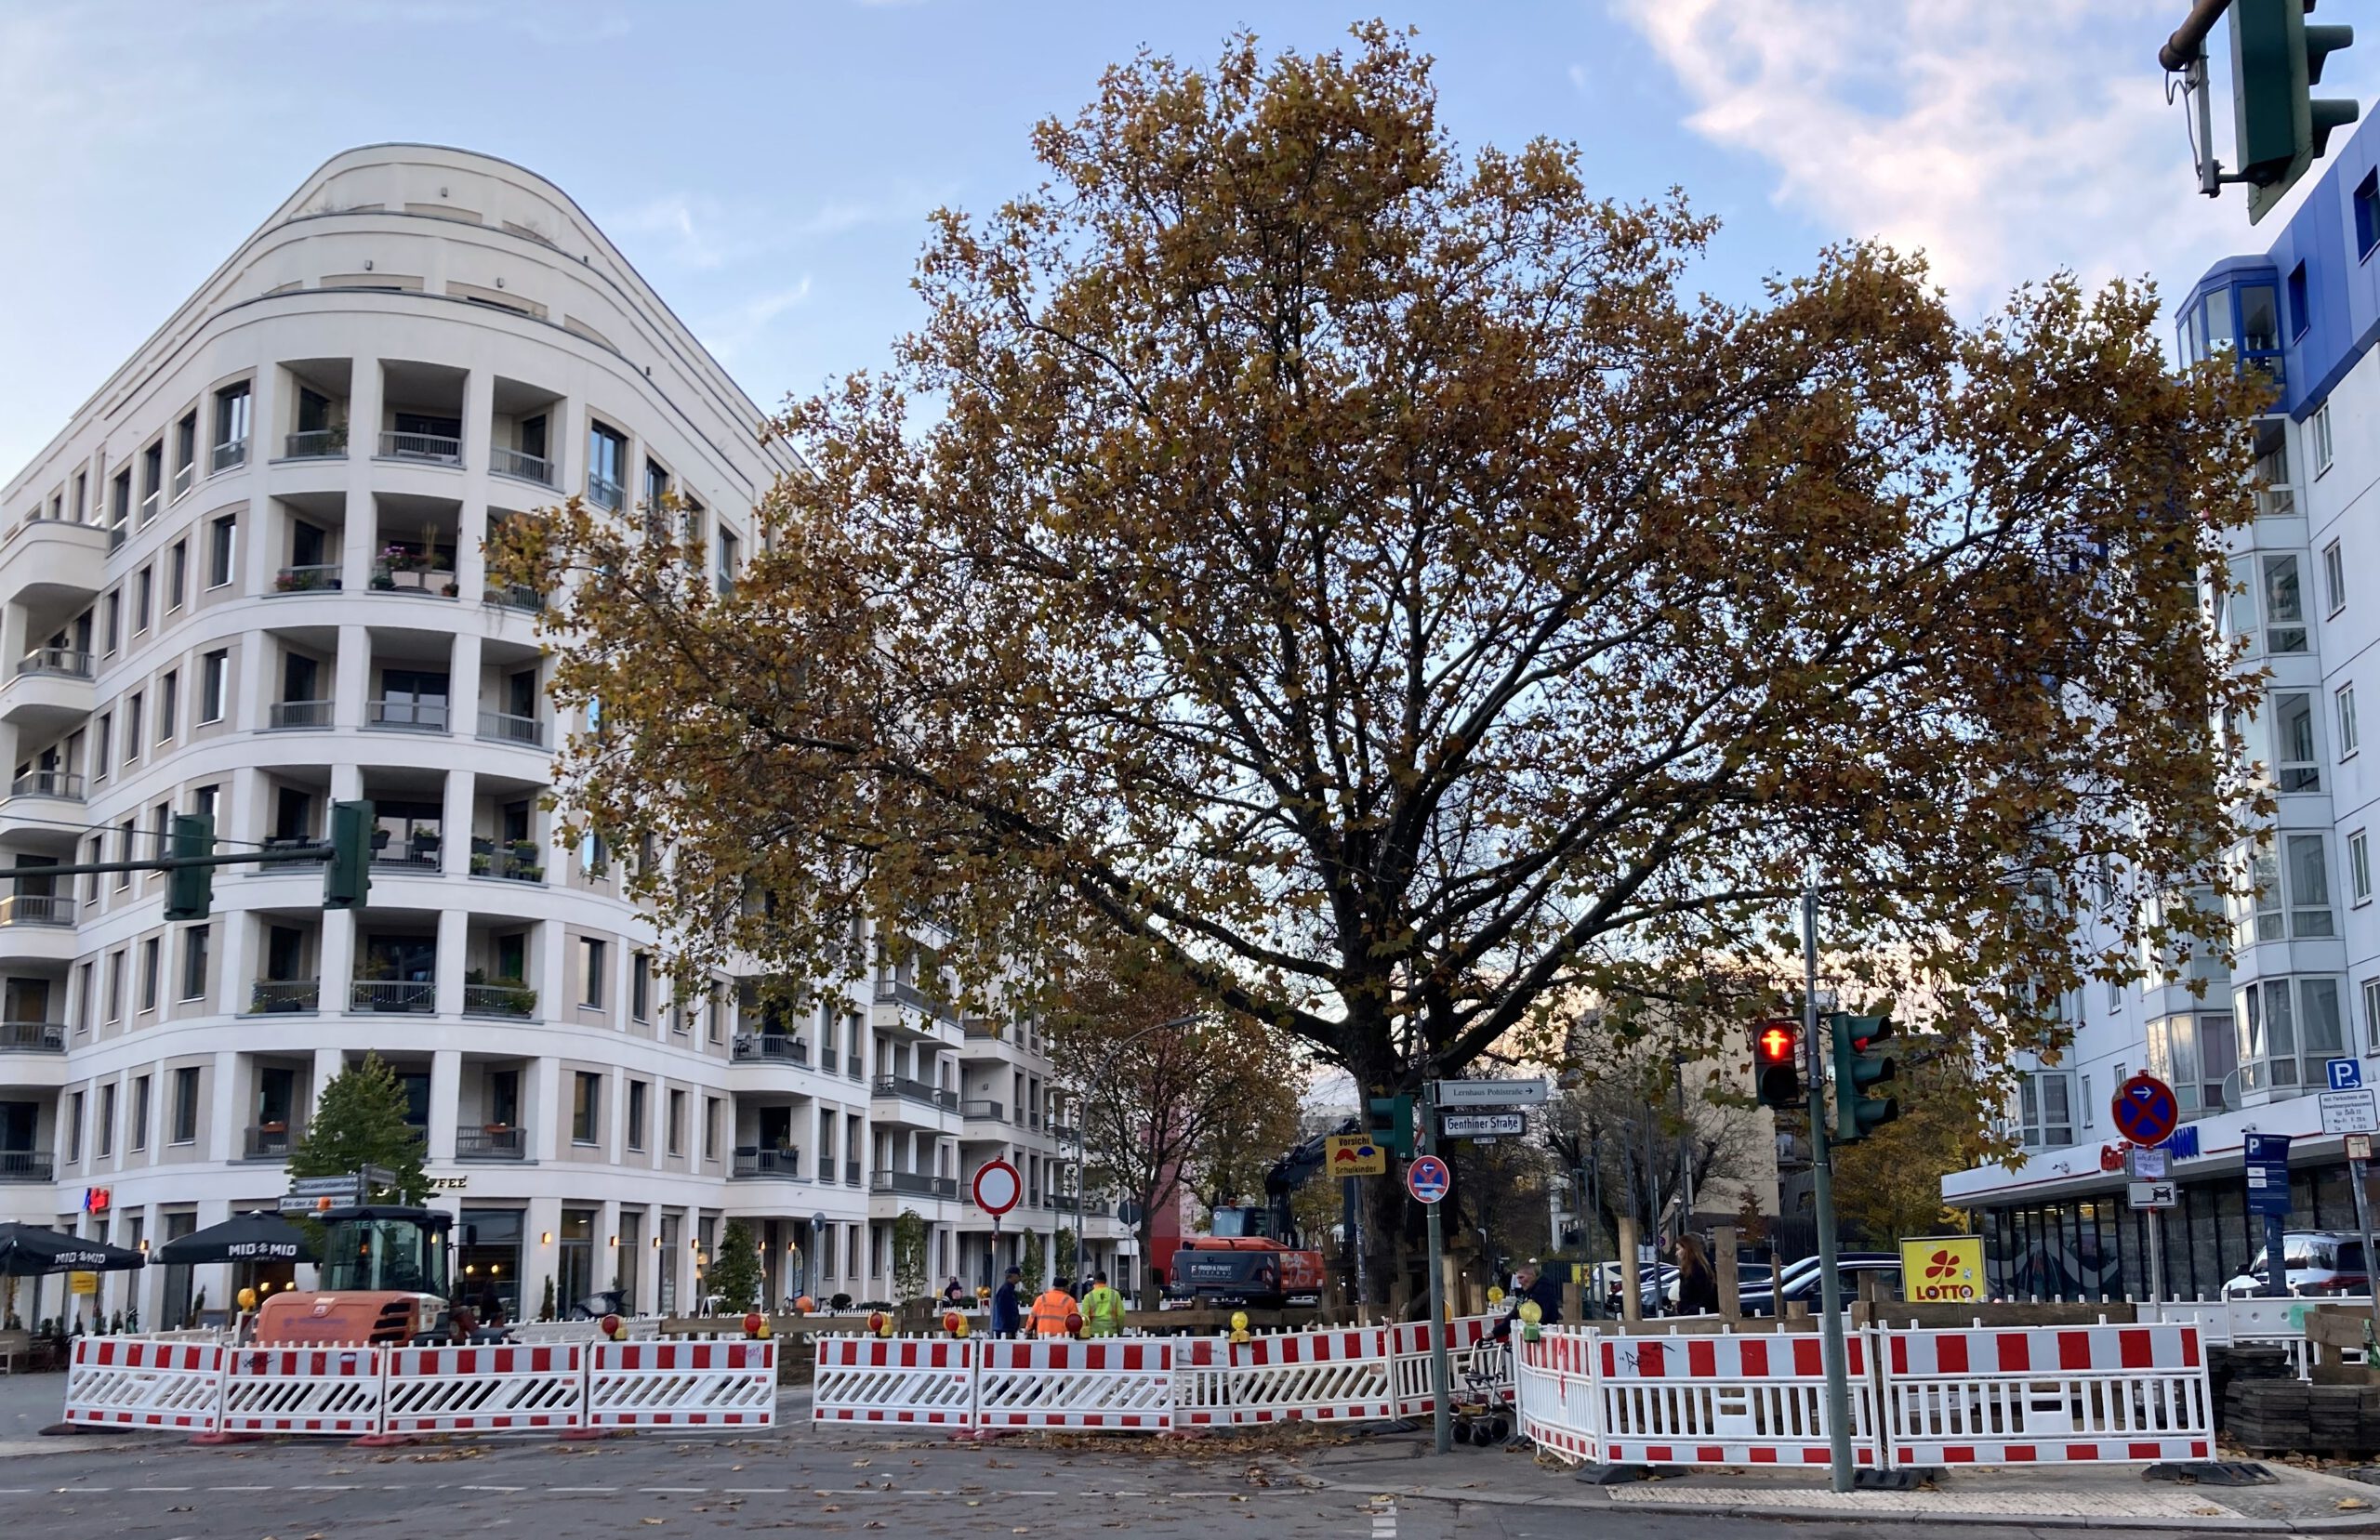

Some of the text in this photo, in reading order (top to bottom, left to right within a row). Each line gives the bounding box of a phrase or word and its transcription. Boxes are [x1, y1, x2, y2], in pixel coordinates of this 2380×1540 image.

[1453, 1086, 1524, 1097] Lernhaus Pohlstraße
[1448, 1116, 1518, 1130] Genthiner Straße
[1339, 1137, 1369, 1146] Vorsicht
[1335, 1166, 1376, 1175] Schulkinder
[229, 1243, 257, 1257] MID
[270, 1244, 298, 1257] MID
[55, 1252, 77, 1264] MID
[86, 1252, 106, 1264] MID
[1916, 1284, 1974, 1300] LOTTO
